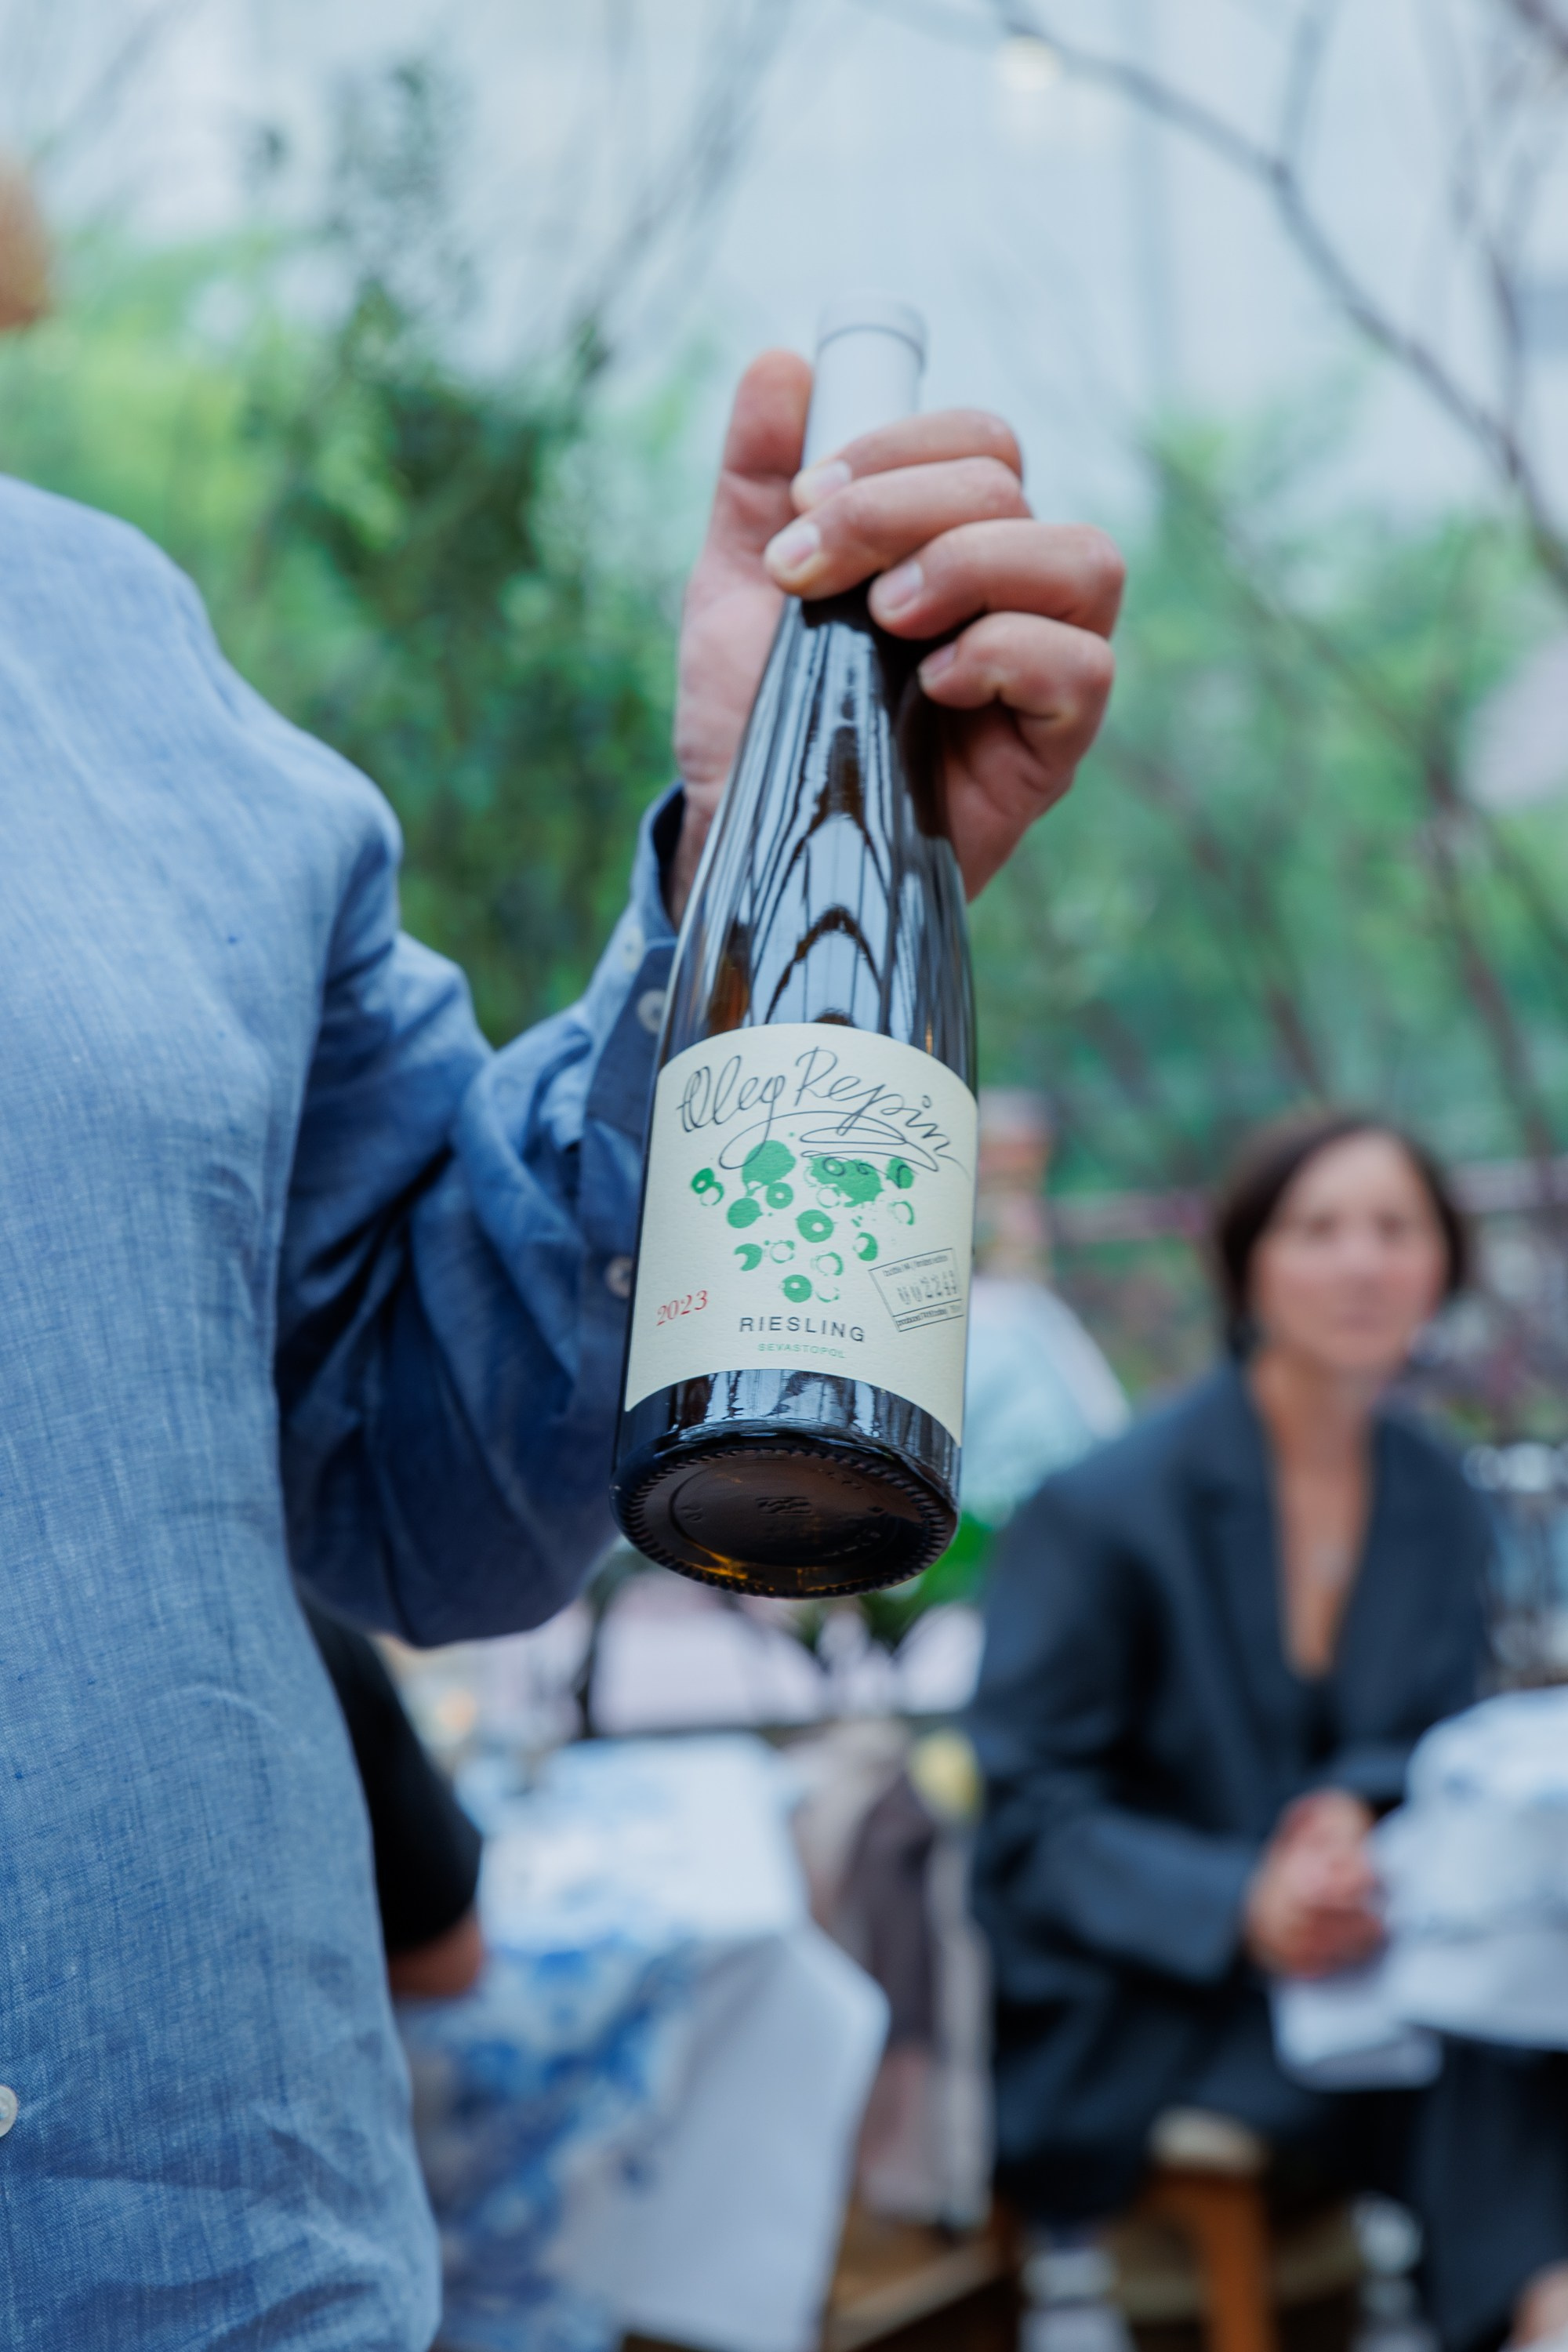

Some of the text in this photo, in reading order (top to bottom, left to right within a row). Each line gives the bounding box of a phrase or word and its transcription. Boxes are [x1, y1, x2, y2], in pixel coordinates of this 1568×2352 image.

[793, 1046, 966, 1168] Repin
[657, 1290, 709, 1326] 2023
[739, 1316, 866, 1342] RIESLING
[757, 1342, 847, 1359] SEVASTOPOL
